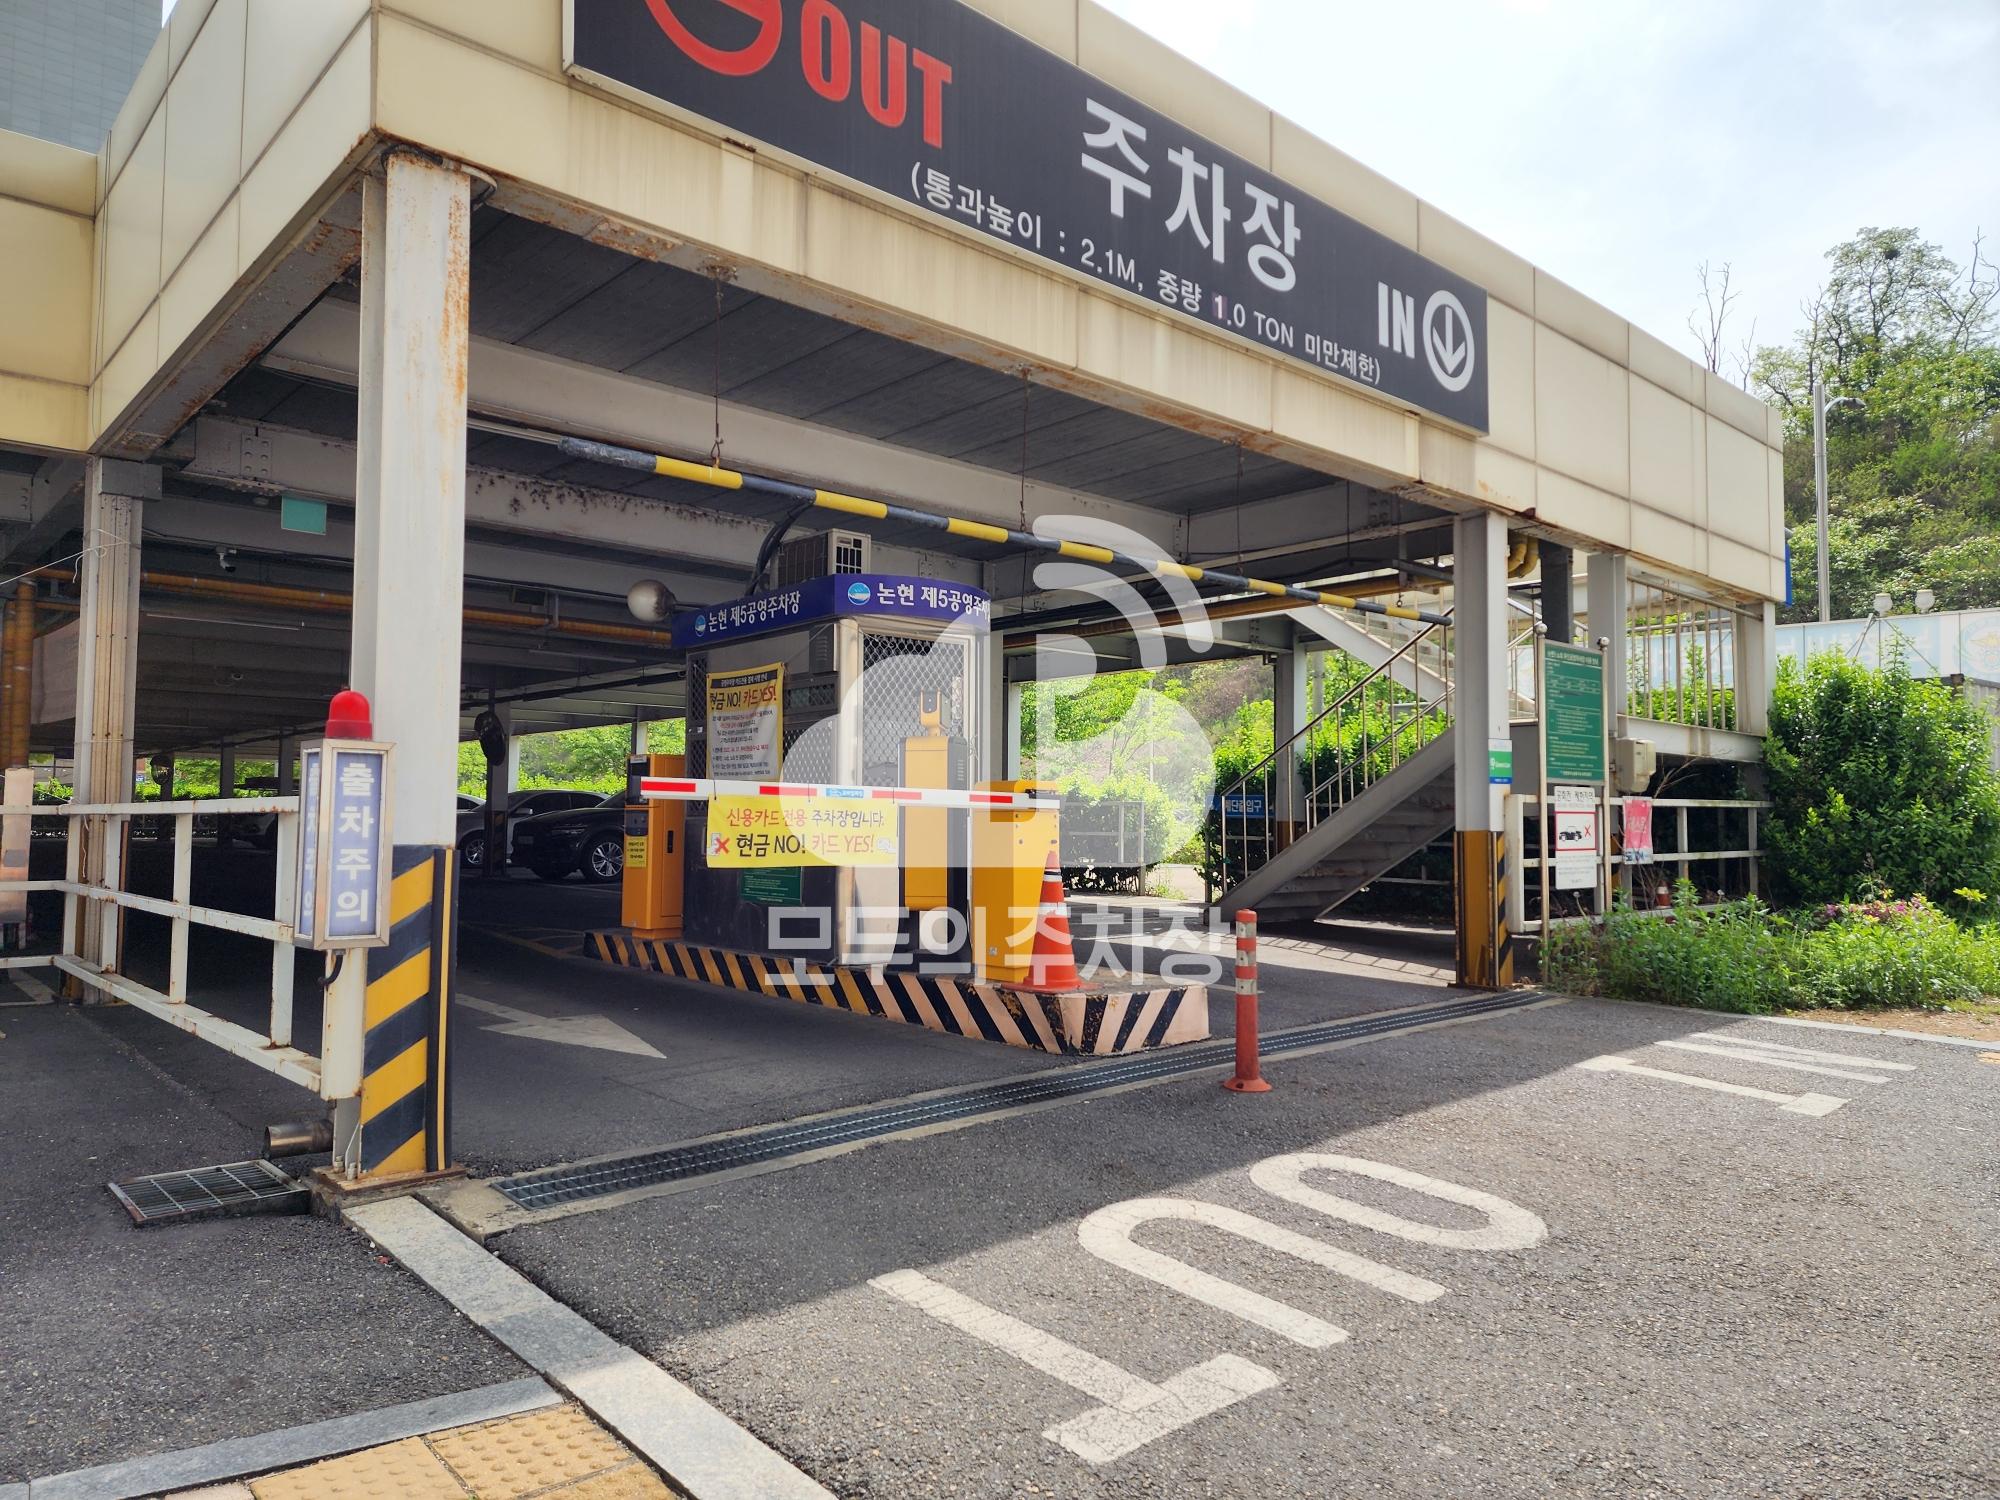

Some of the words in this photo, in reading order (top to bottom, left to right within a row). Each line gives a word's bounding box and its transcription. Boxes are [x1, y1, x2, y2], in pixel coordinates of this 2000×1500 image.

[800, 0, 953, 150] OUT
[1081, 97, 1301, 293] 주차장
[911, 161, 1042, 250] (통과높이
[1081, 238, 1144, 292] 2.1M,
[1157, 268, 1202, 314] 중량
[1214, 294, 1247, 329] 1.0
[1254, 310, 1295, 349] TON
[1305, 332, 1382, 386] 미만제한)
[1377, 280, 1416, 360] IN
[708, 608, 728, 633] 논현
[730, 590, 801, 627] 제5공영주차장
[876, 582, 915, 606] 논현
[920, 586, 991, 623] 제5공영주차
[710, 690, 725, 711] 현금
[726, 690, 742, 708] NO!
[335, 762, 375, 923] 출차주의
[727, 808, 780, 828] 신용카드
[782, 809, 808, 828] 전용
[811, 810, 885, 828] 주차장입니다.
[736, 833, 771, 858] 현금
[774, 834, 806, 855] NO!
[812, 834, 841, 856] 카드
[844, 833, 875, 854] YES!
[866, 1152, 1549, 1464] OUT
